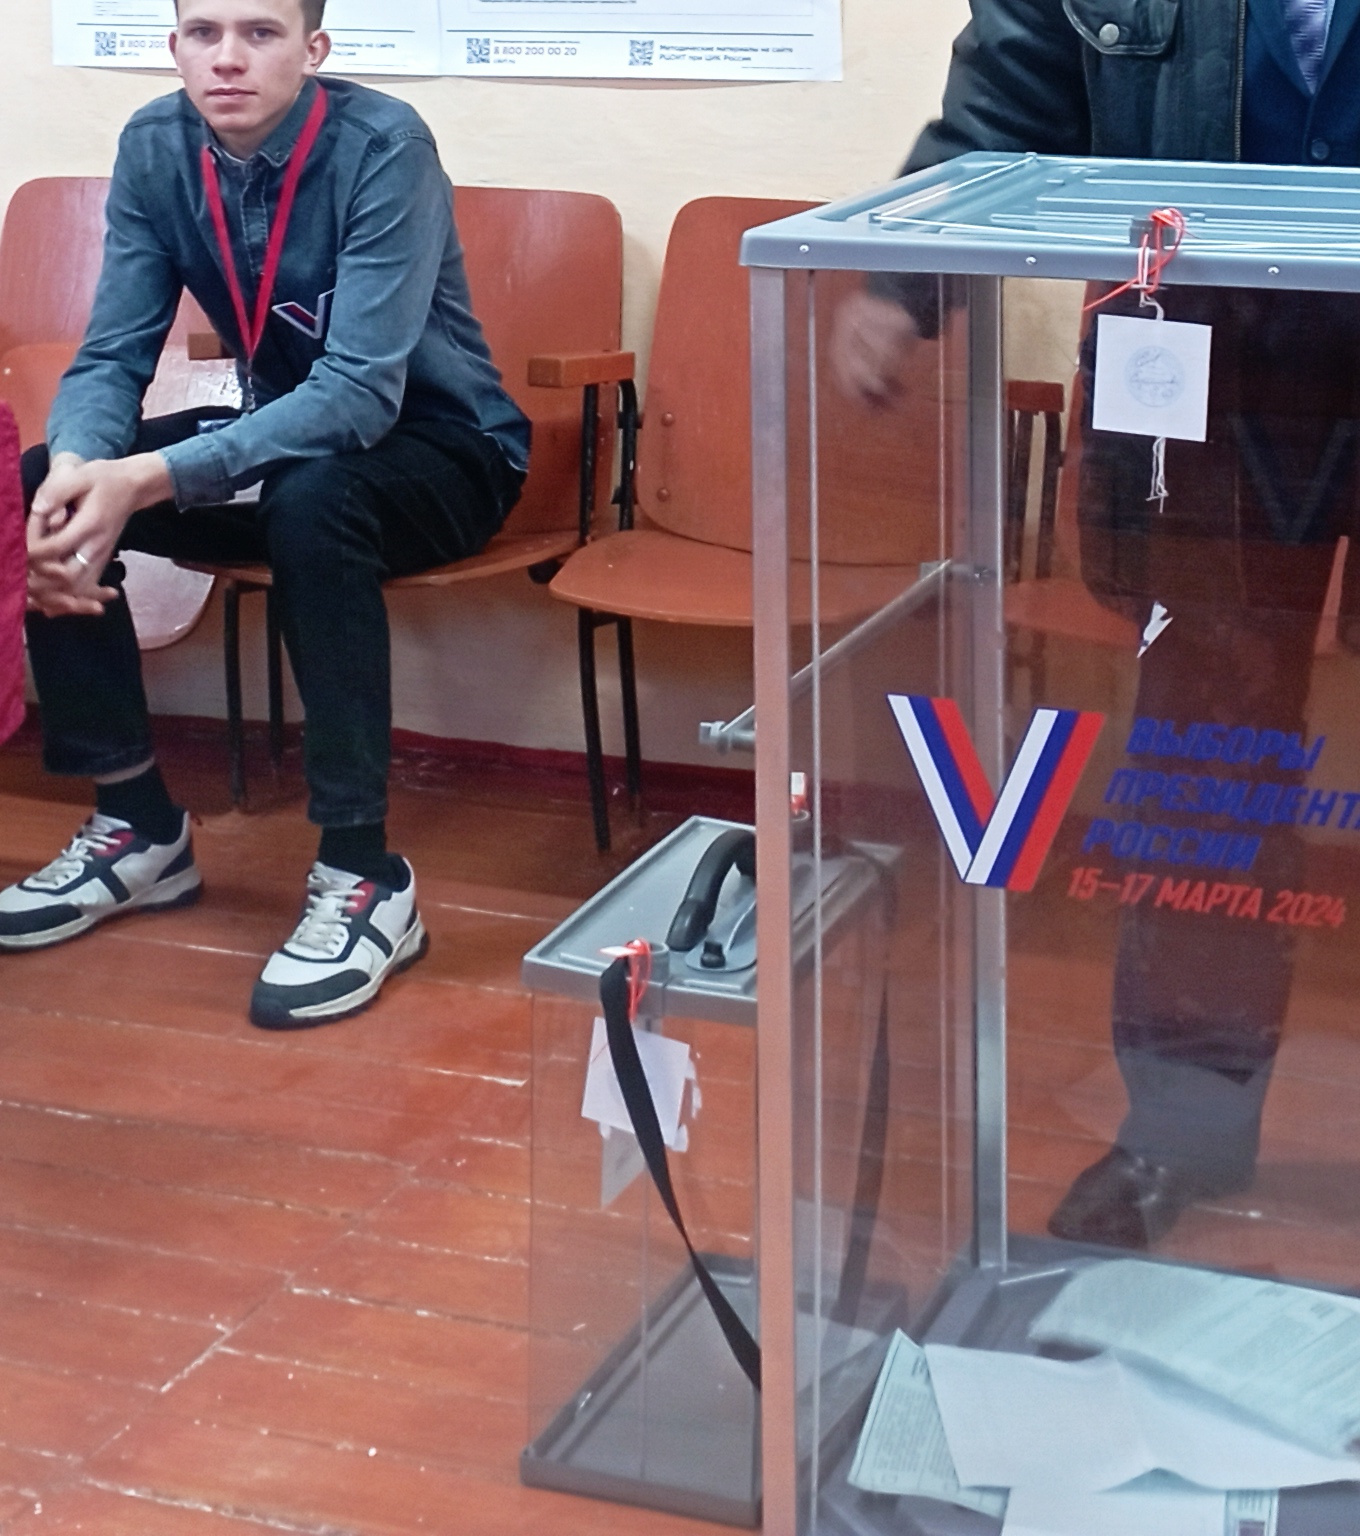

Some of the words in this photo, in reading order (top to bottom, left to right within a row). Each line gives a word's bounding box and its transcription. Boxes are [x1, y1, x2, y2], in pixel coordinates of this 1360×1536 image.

[502, 46, 522, 55] 800
[525, 46, 545, 56] 200
[547, 46, 561, 56] 00
[563, 46, 578, 56] 20
[1125, 716, 1327, 772] ВЫБОРЫ
[1080, 817, 1263, 873] РОССИИ
[1153, 876, 1264, 920] МАРТА
[1265, 888, 1347, 928] 2024
